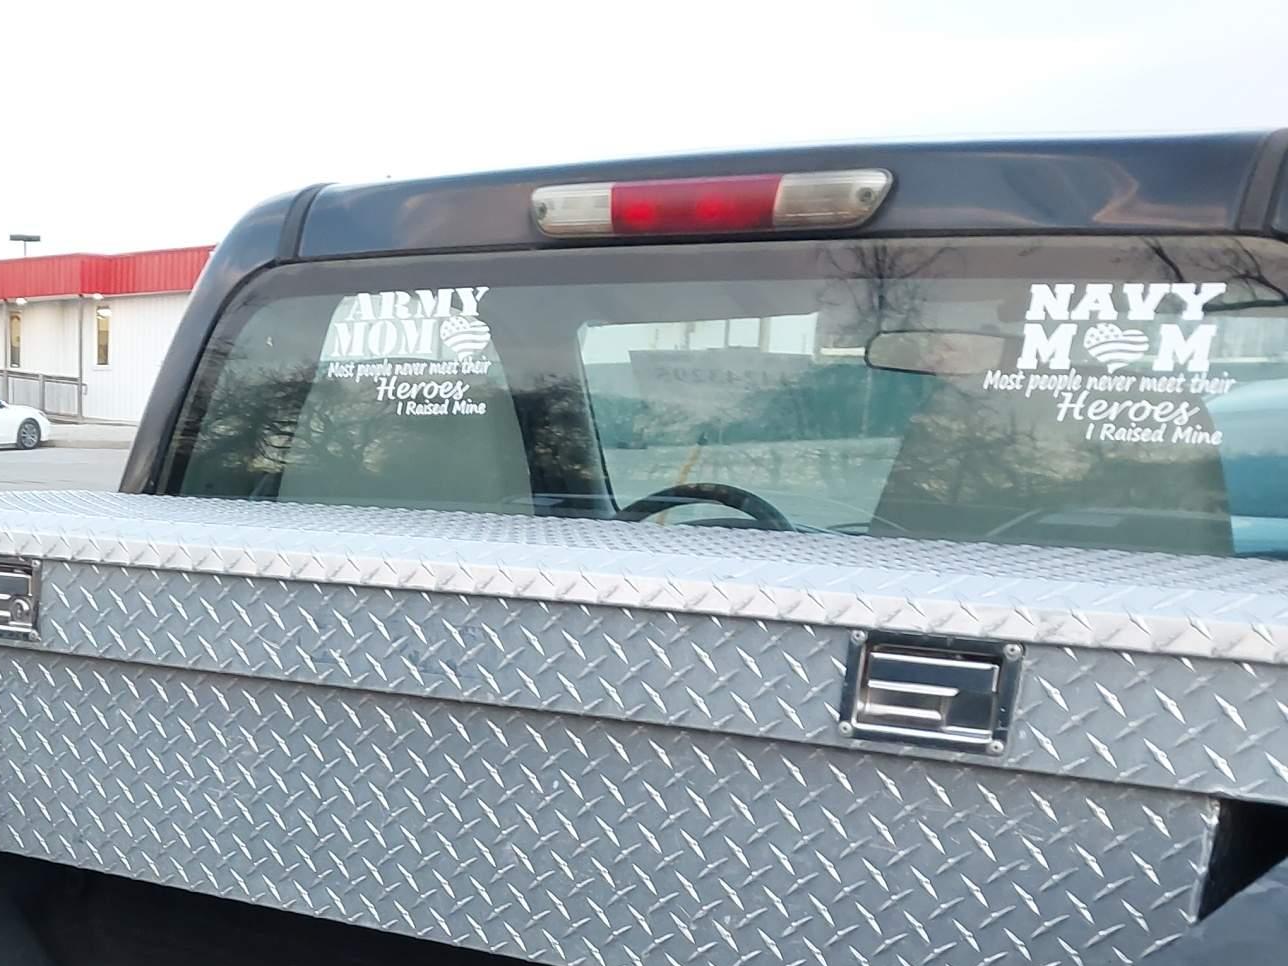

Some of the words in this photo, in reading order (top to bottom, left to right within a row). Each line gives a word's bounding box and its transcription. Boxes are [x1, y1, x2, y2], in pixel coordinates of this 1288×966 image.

[345, 286, 490, 321] ARMY
[1025, 283, 1227, 321] NAVY
[329, 319, 437, 357] MOM
[328, 362, 355, 378] Most
[355, 358, 393, 383] people
[394, 362, 428, 376] never
[429, 362, 459, 375] meet
[460, 355, 491, 375] their
[983, 370, 1025, 390] Most
[1025, 368, 1082, 398] people
[1086, 374, 1136, 393] never
[1138, 374, 1186, 393] meet
[1190, 372, 1237, 395] their
[374, 376, 470, 401] Heroes
[396, 403, 403, 416] I
[405, 401, 449, 415] Raised
[452, 400, 487, 415] Mine
[1057, 391, 1200, 426] Heroes
[1085, 423, 1094, 441] I
[1099, 422, 1167, 443] Raised
[1171, 425, 1224, 446] Mine
